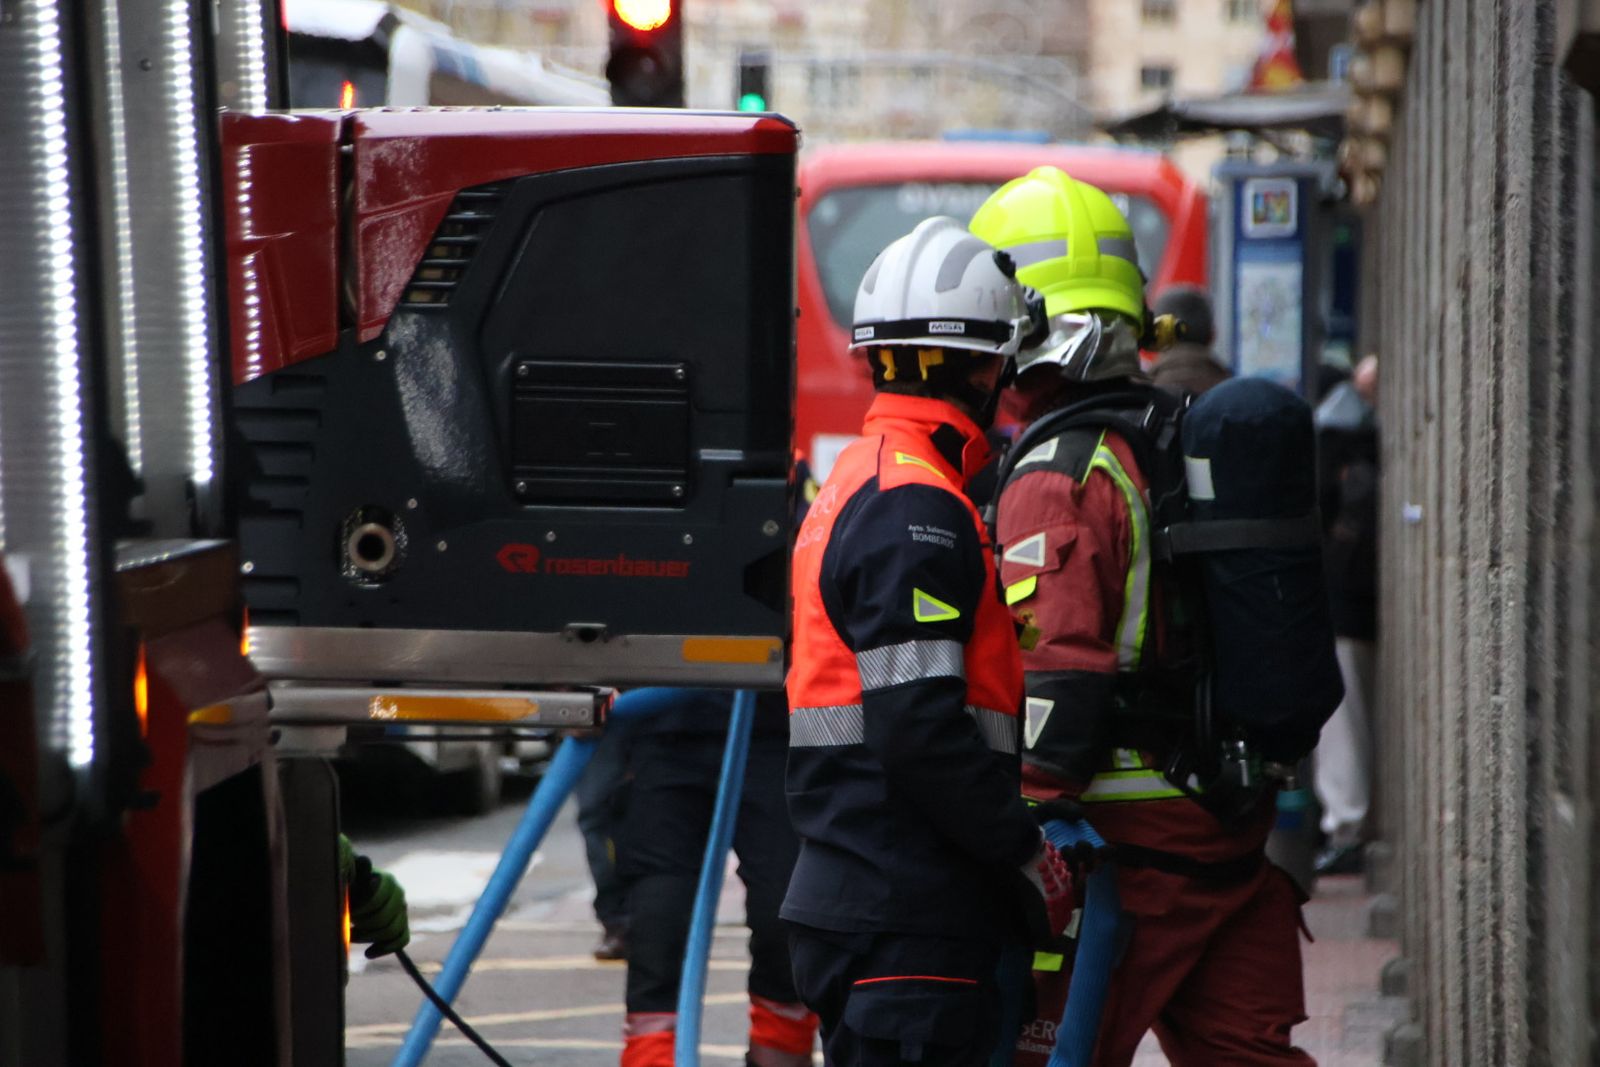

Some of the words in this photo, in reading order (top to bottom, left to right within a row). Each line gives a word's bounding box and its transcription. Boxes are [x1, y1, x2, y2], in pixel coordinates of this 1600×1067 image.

[930, 323, 964, 332] MSA
[912, 532, 954, 549] BOMBEROS
[544, 552, 692, 577] rosenbauer
